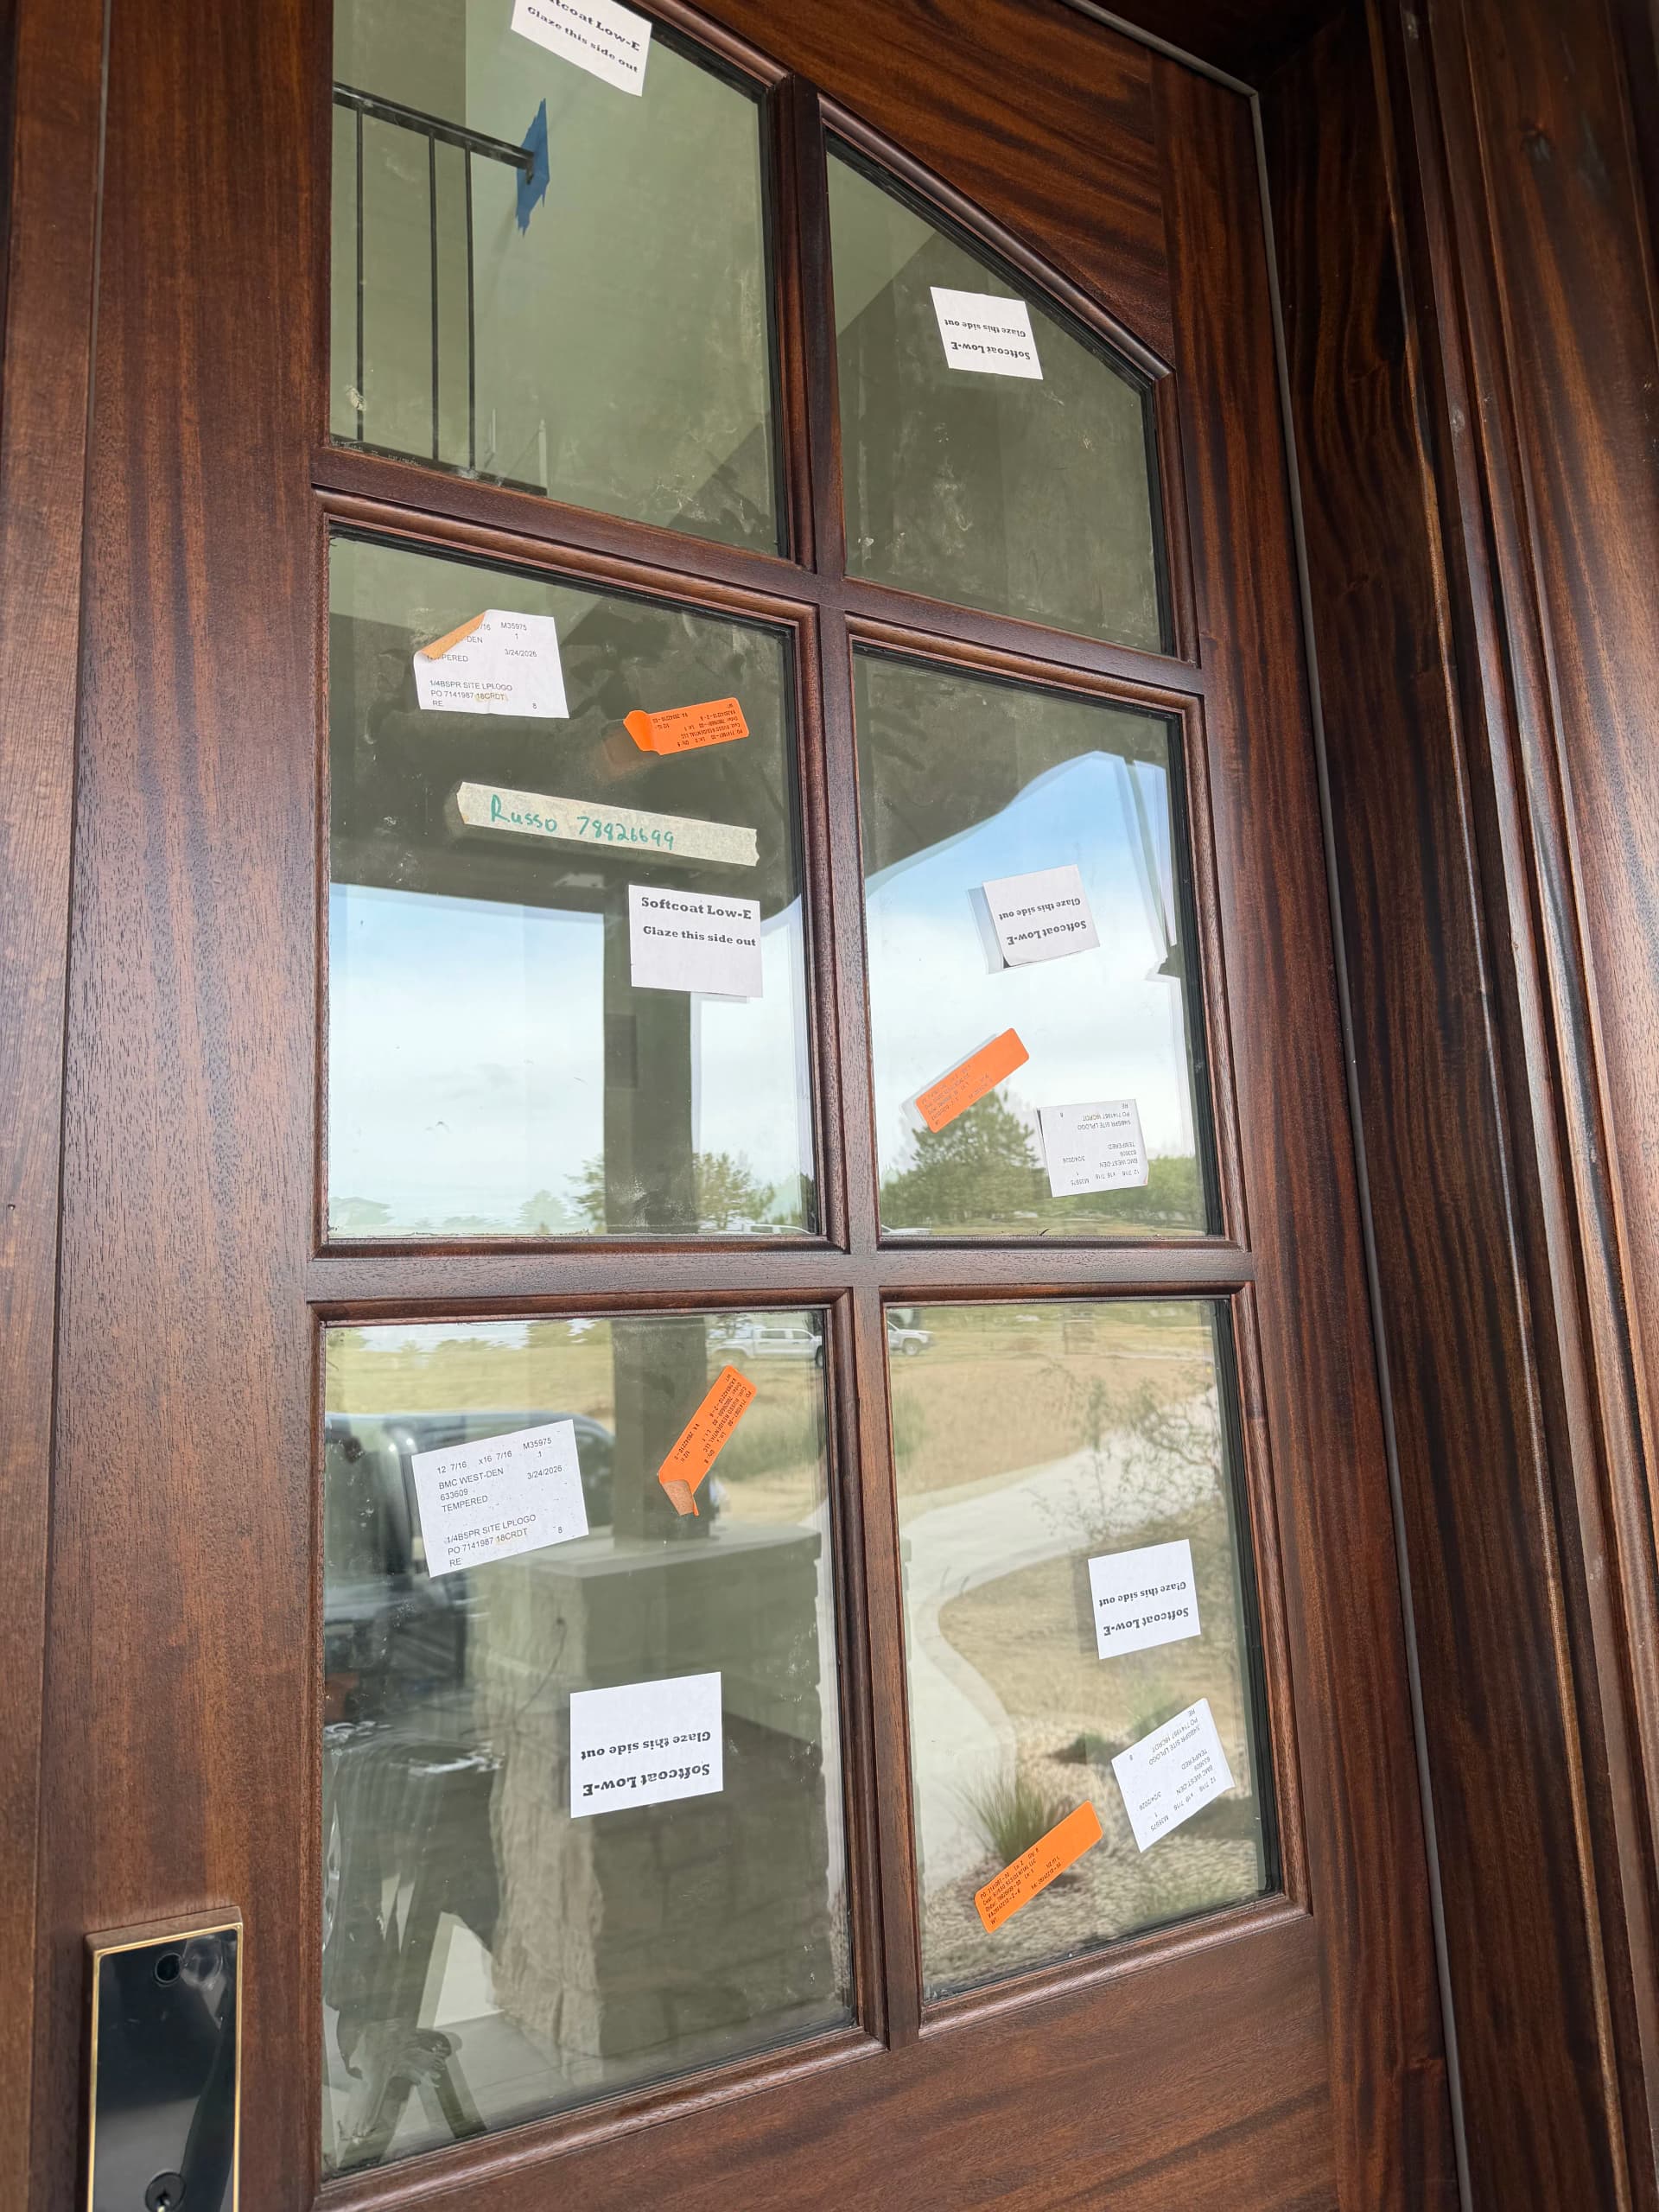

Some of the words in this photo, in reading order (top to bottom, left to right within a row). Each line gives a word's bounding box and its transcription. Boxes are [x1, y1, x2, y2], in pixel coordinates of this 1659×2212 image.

[548, 0, 594, 25] tcoat
[596, 22, 640, 51] Low-E
[528, 7, 562, 29] Glaze
[565, 28, 588, 44] this
[591, 42, 615, 59] side
[619, 59, 638, 73] out
[983, 325, 1000, 334] this
[1001, 328, 1026, 337] Glaze
[951, 342, 985, 353] Low-E
[987, 348, 1030, 359] Softcoat
[500, 622, 527, 631] M35975
[427, 653, 468, 662] PERED
[490, 794, 557, 832] Russo
[641, 897, 704, 914] Softcoat
[707, 905, 752, 919] Low-E
[1037, 904, 1054, 912] this
[1056, 899, 1080, 907] Glaze
[999, 912, 1014, 920] out
[1017, 907, 1035, 916] side
[1043, 920, 1086, 933] Softcoat
[643, 926, 678, 938] Glaze
[682, 930, 706, 941] this
[708, 933, 733, 944] side
[736, 937, 756, 946] out
[1007, 931, 1041, 945] Low-E
[523, 1438, 551, 1450] M35975
[450, 1461, 467, 1471] 7/16
[479, 1455, 492, 1465] x16
[497, 1451, 512, 1460] 7/16
[439, 1478, 457, 1490] BMC
[460, 1467, 504, 1485] WEST-DEN
[441, 1489, 468, 1501] 633609
[442, 1495, 487, 1512] TEMPERED
[482, 1522, 500, 1535] SITE
[503, 1514, 536, 1530] LPLOGO
[448, 1546, 461, 1555] PO
[462, 1537, 493, 1551] 7141987
[1160, 1581, 1186, 1592] Glaze
[1118, 1592, 1138, 1602] side
[1140, 1587, 1158, 1599] this
[1099, 1597, 1115, 1607] out
[1141, 1608, 1189, 1626] Softcoat
[1103, 1619, 1141, 1636] Low-E
[1187, 1707, 1195, 1717] RE
[1189, 1716, 1198, 1726] PO
[673, 1731, 711, 1743] Glaze
[609, 1742, 639, 1755] side
[643, 1738, 670, 1750] this
[1169, 1738, 1180, 1751] SITE
[581, 1748, 605, 1760] out
[640, 1764, 709, 1785] Softcoat
[582, 1777, 637, 1796] Low-E
